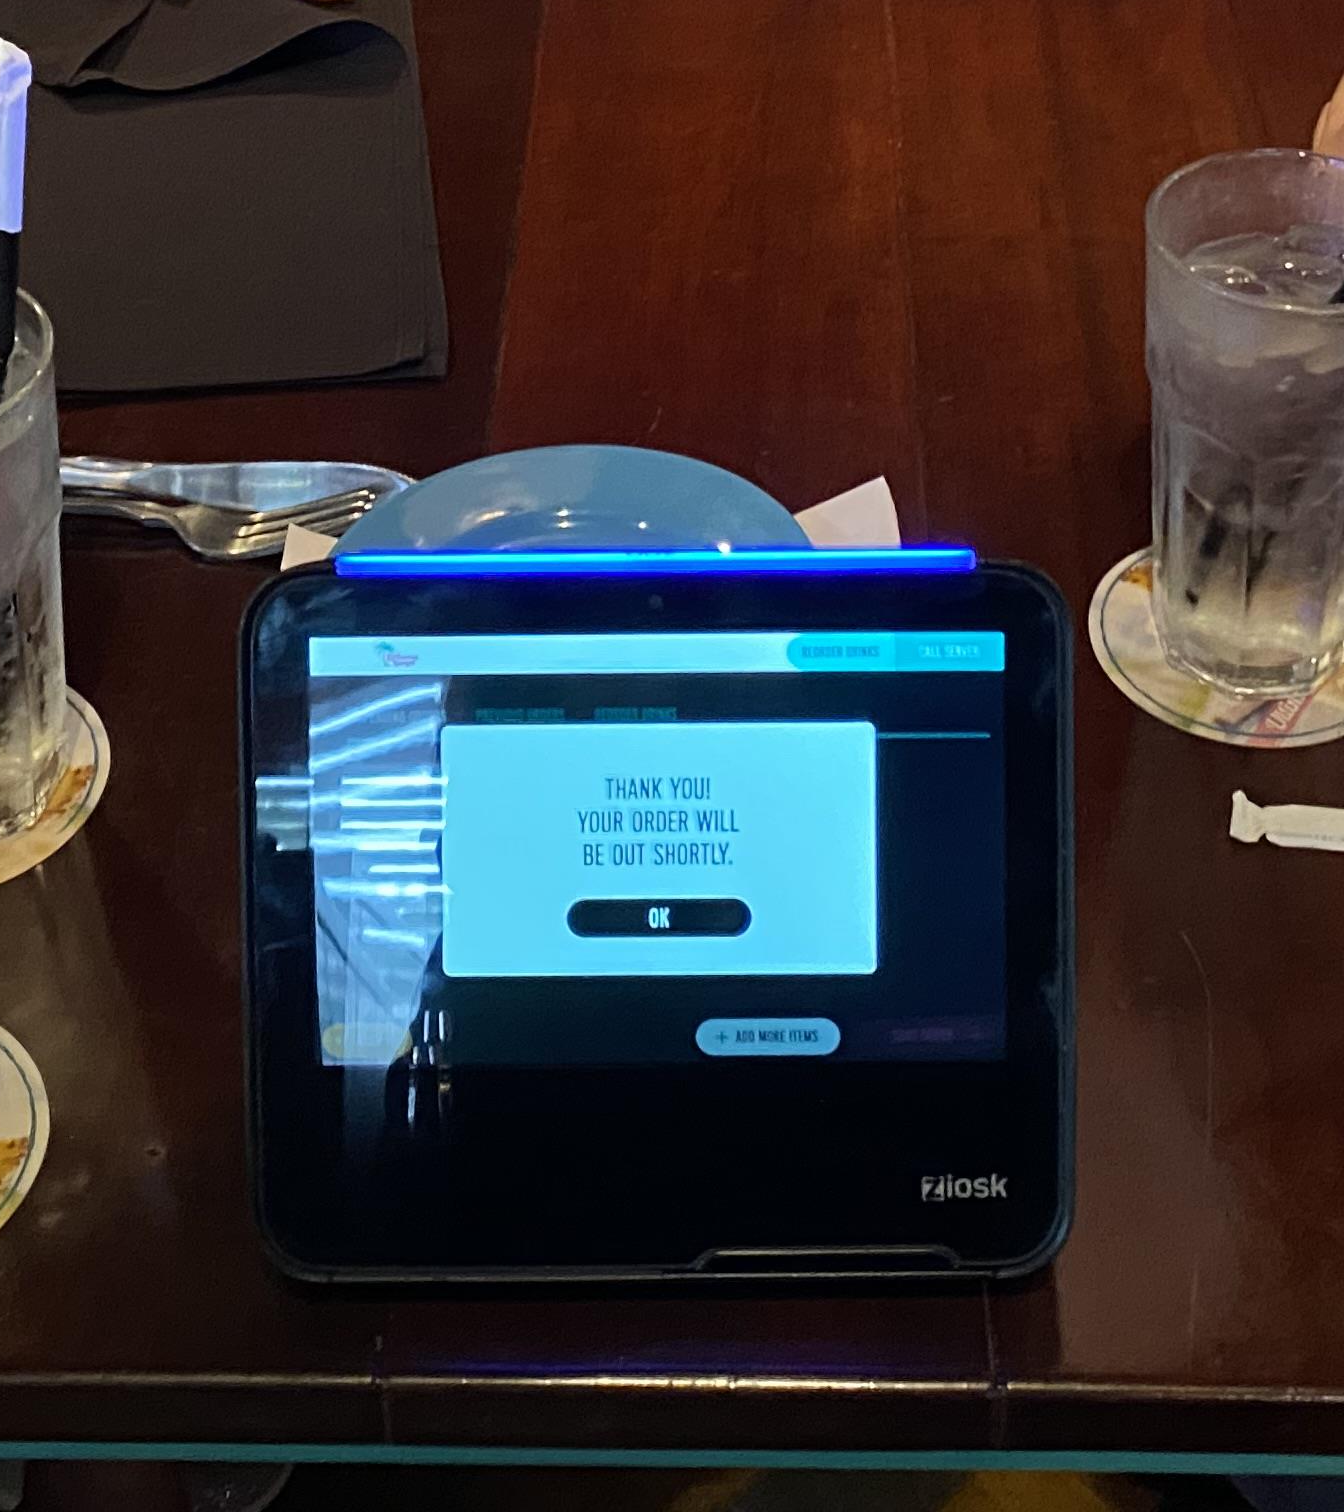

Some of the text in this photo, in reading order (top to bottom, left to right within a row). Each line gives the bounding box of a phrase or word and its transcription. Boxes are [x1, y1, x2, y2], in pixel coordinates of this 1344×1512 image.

[918, 644, 980, 659] CALL SERVER
[605, 776, 711, 800] THANK YOU!
[577, 809, 740, 833] YOUR ORDER WILL
[583, 842, 734, 866] BE OUT SHORTLY.
[648, 906, 671, 929] OK
[735, 1029, 819, 1043] ADD MORE ITEMS
